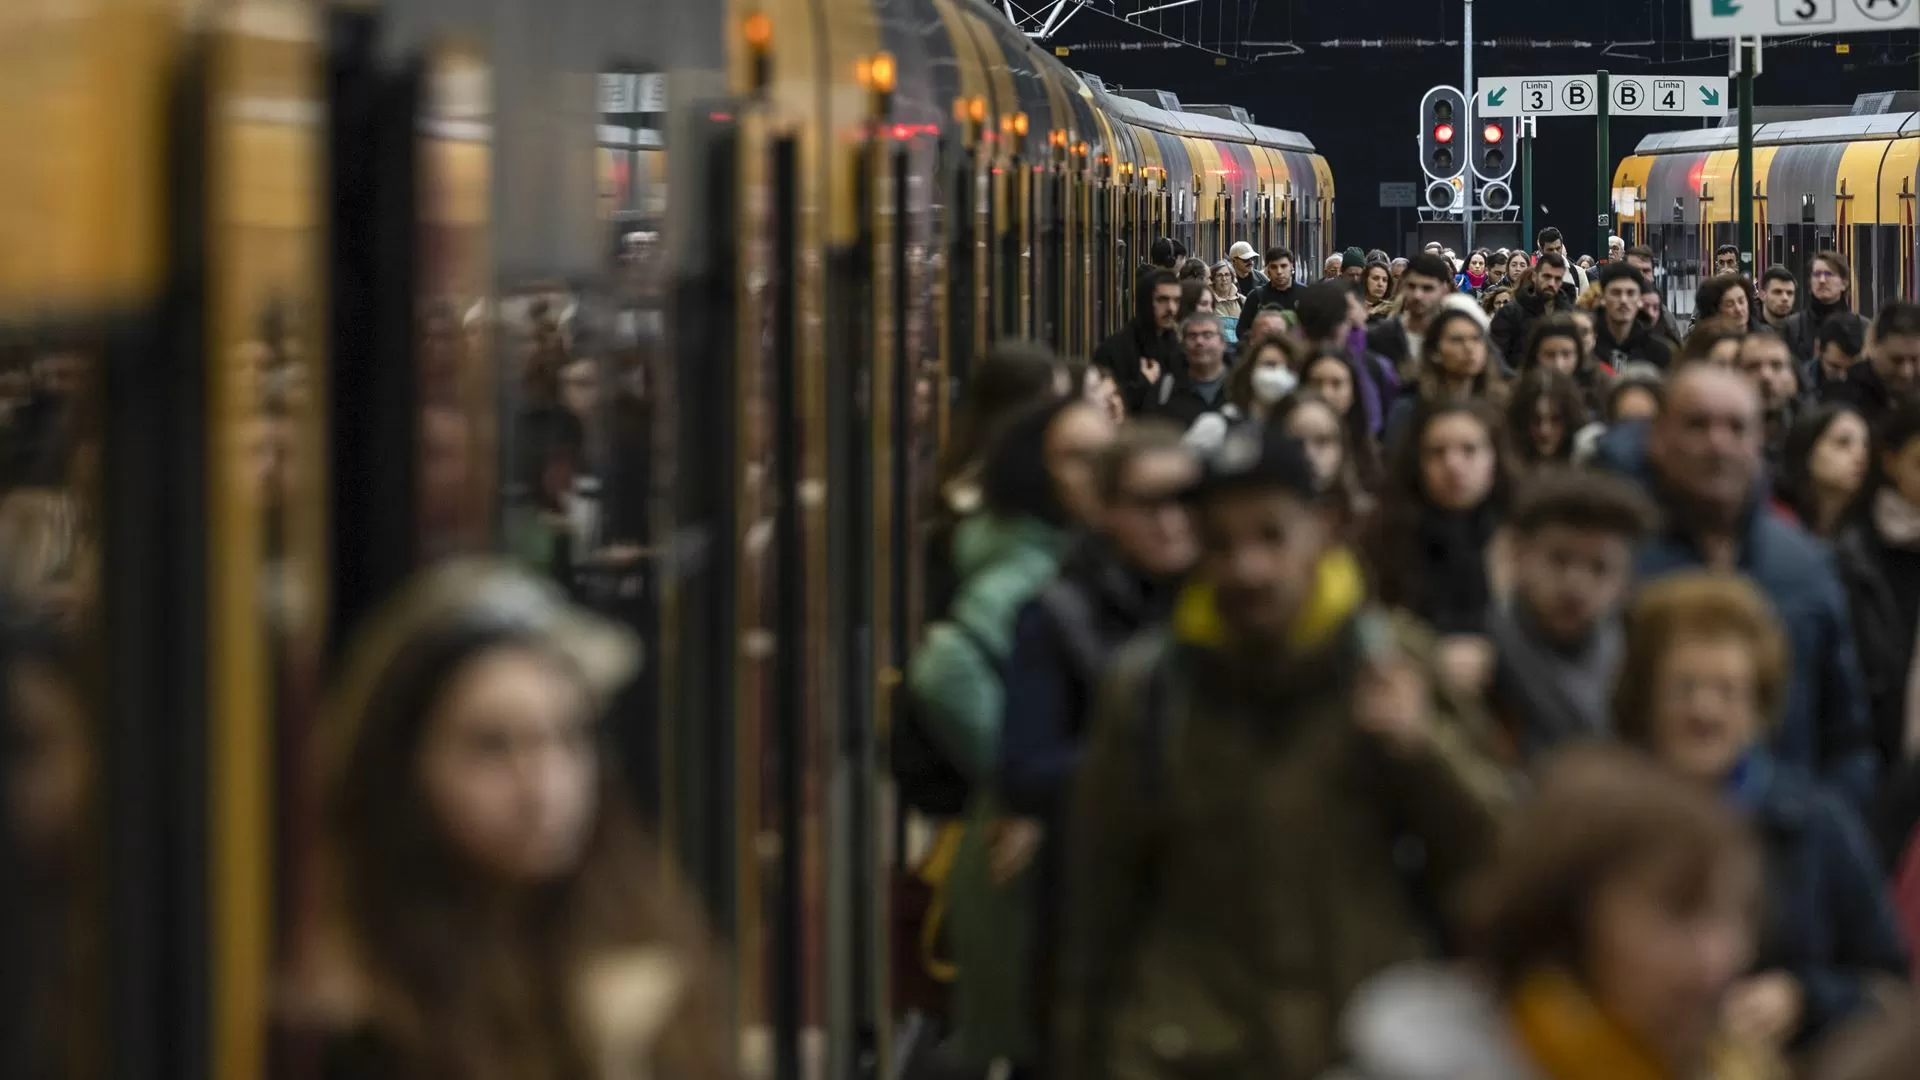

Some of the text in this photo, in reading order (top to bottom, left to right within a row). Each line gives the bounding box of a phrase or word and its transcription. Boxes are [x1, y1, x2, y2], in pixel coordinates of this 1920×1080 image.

[1531, 91, 1544, 109] 3
[1569, 86, 1586, 105] B
[1621, 86, 1637, 105] B
[1662, 90, 1676, 109] 4
